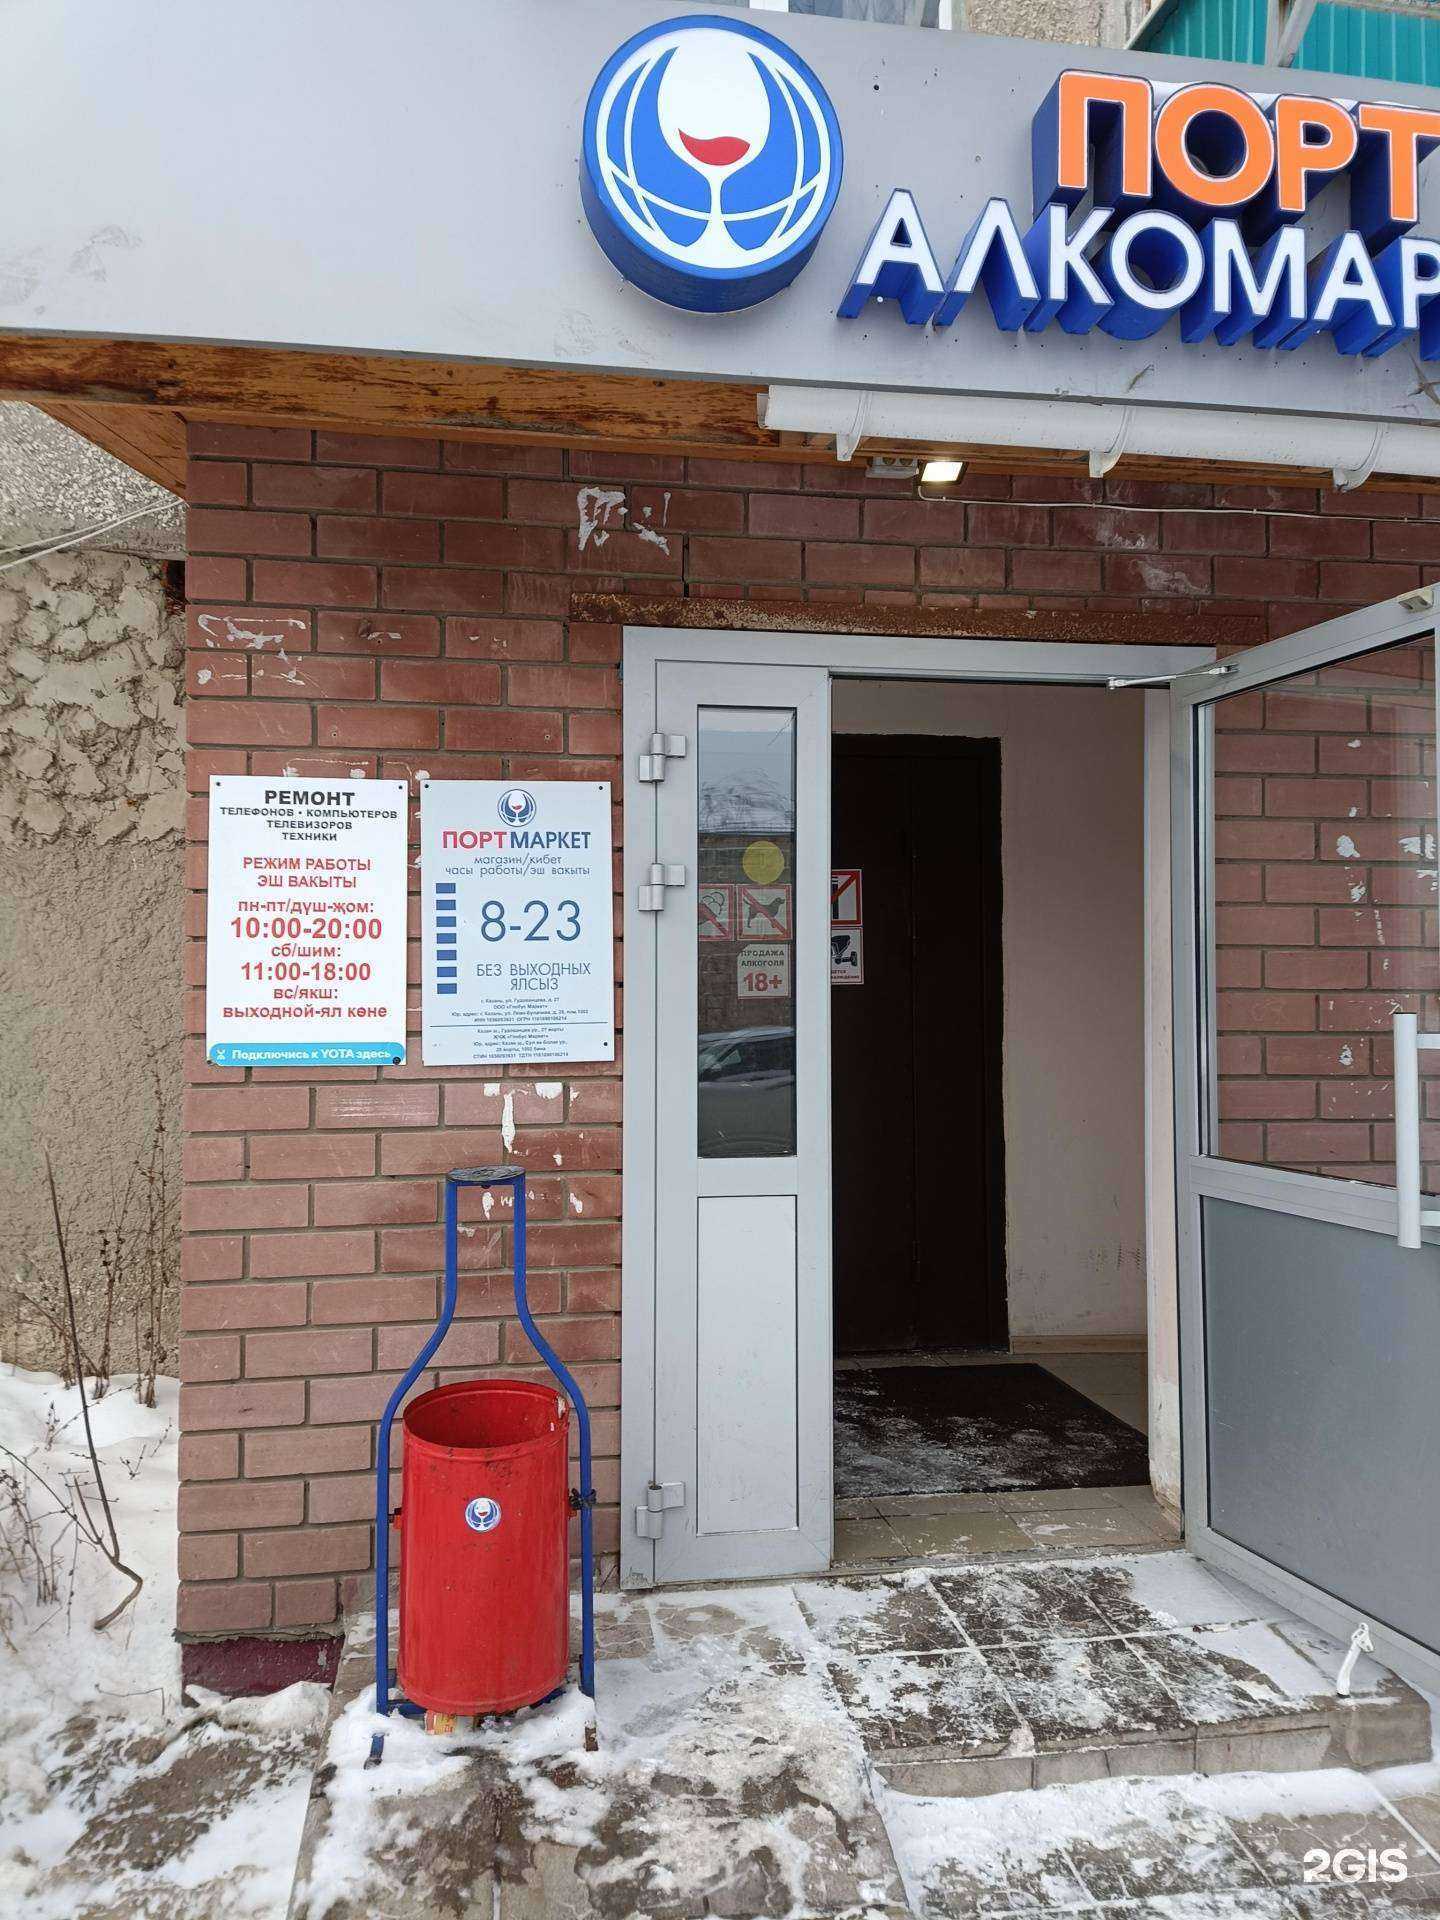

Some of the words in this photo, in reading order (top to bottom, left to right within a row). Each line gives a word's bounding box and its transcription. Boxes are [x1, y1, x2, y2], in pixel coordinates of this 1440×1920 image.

[1056, 68, 1440, 223] ПОРТ
[854, 188, 1440, 329] АЛКОМАР
[264, 790, 355, 806] РЕМОНТ
[220, 807, 294, 817] ТЕЛЕФОНОВ
[306, 809, 398, 819] КОМПЬЮТЕРОВ
[267, 820, 353, 830] ТЕЛЕВИЗОРОВ
[282, 832, 338, 842] ТЕХНИКИ
[243, 857, 301, 870] РЕЖИМ
[305, 858, 371, 871] РАБОТЫ
[474, 852, 562, 866] магазин/кибет
[445, 866, 473, 875] часы
[480, 863, 545, 878] работы/эш
[551, 866, 590, 875] вакыты
[257, 875, 283, 888] ЭШ
[288, 876, 357, 889] ВАКЫТЫ
[230, 916, 382, 940] 10:00-20:00
[480, 899, 581, 943] 8-23
[271, 943, 342, 958] сб/шим:
[741, 950, 785, 958] ПРОДАЖА
[476, 963, 503, 977] БЕЗ
[509, 962, 592, 978] ВЫХОДНЫХ
[741, 959, 785, 967] АЛКОГОЛЯ
[241, 961, 371, 982] 11:00-18:00
[510, 977, 559, 991] ЯЛСЫЗ
[743, 972, 782, 992] 18+
[273, 985, 339, 1000] вс/якш:
[231, 1049, 310, 1061] Подключись
[311, 1050, 319, 1059] к
[320, 1049, 354, 1060] YOTA
[356, 1050, 391, 1061] здесь
